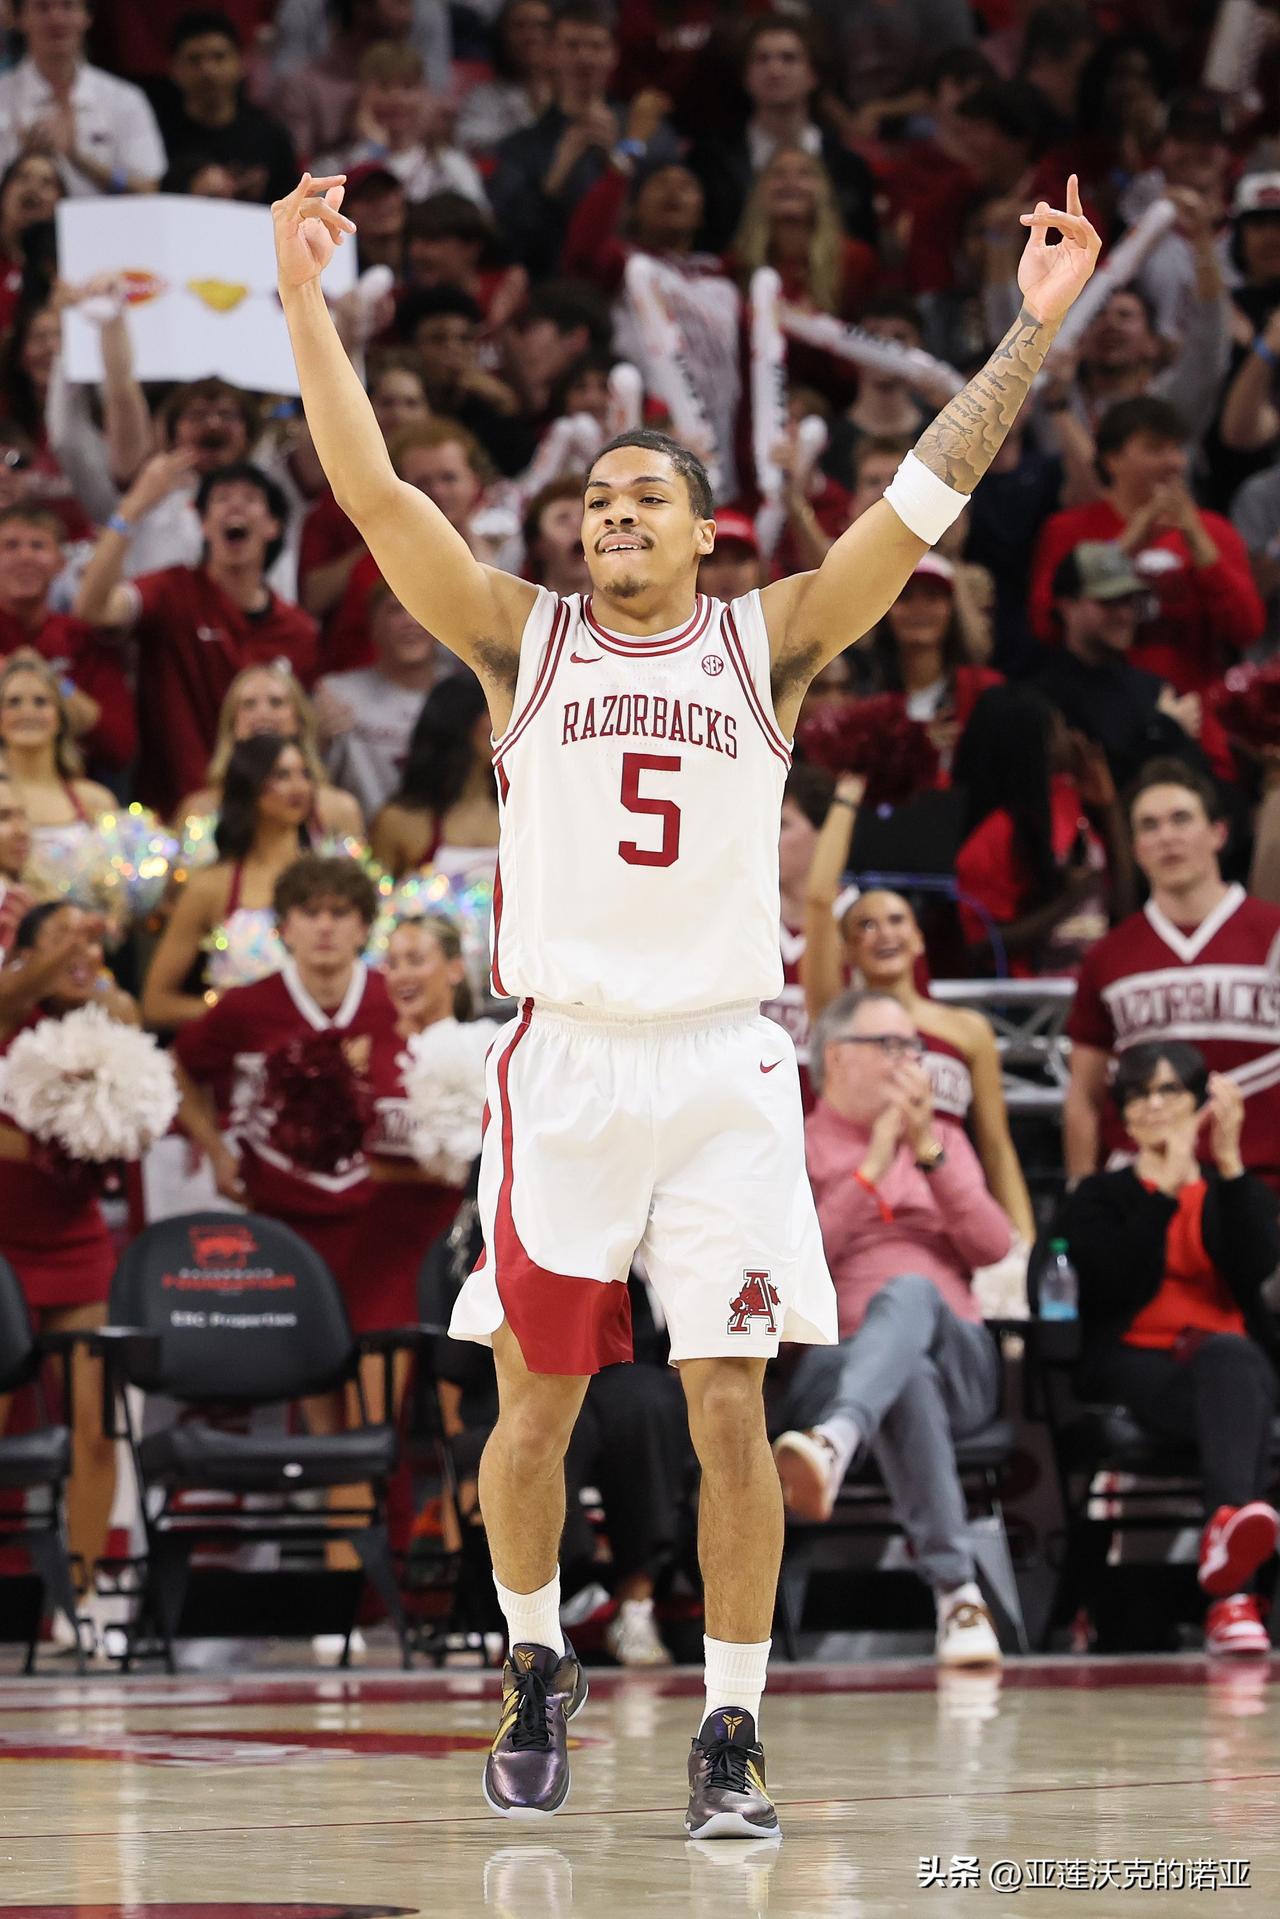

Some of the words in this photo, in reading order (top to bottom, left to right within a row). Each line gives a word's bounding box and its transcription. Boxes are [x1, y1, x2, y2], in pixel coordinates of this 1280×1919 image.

[701, 654, 724, 677] SEC
[561, 694, 737, 759] RAZORBACKS
[618, 752, 682, 868] 5
